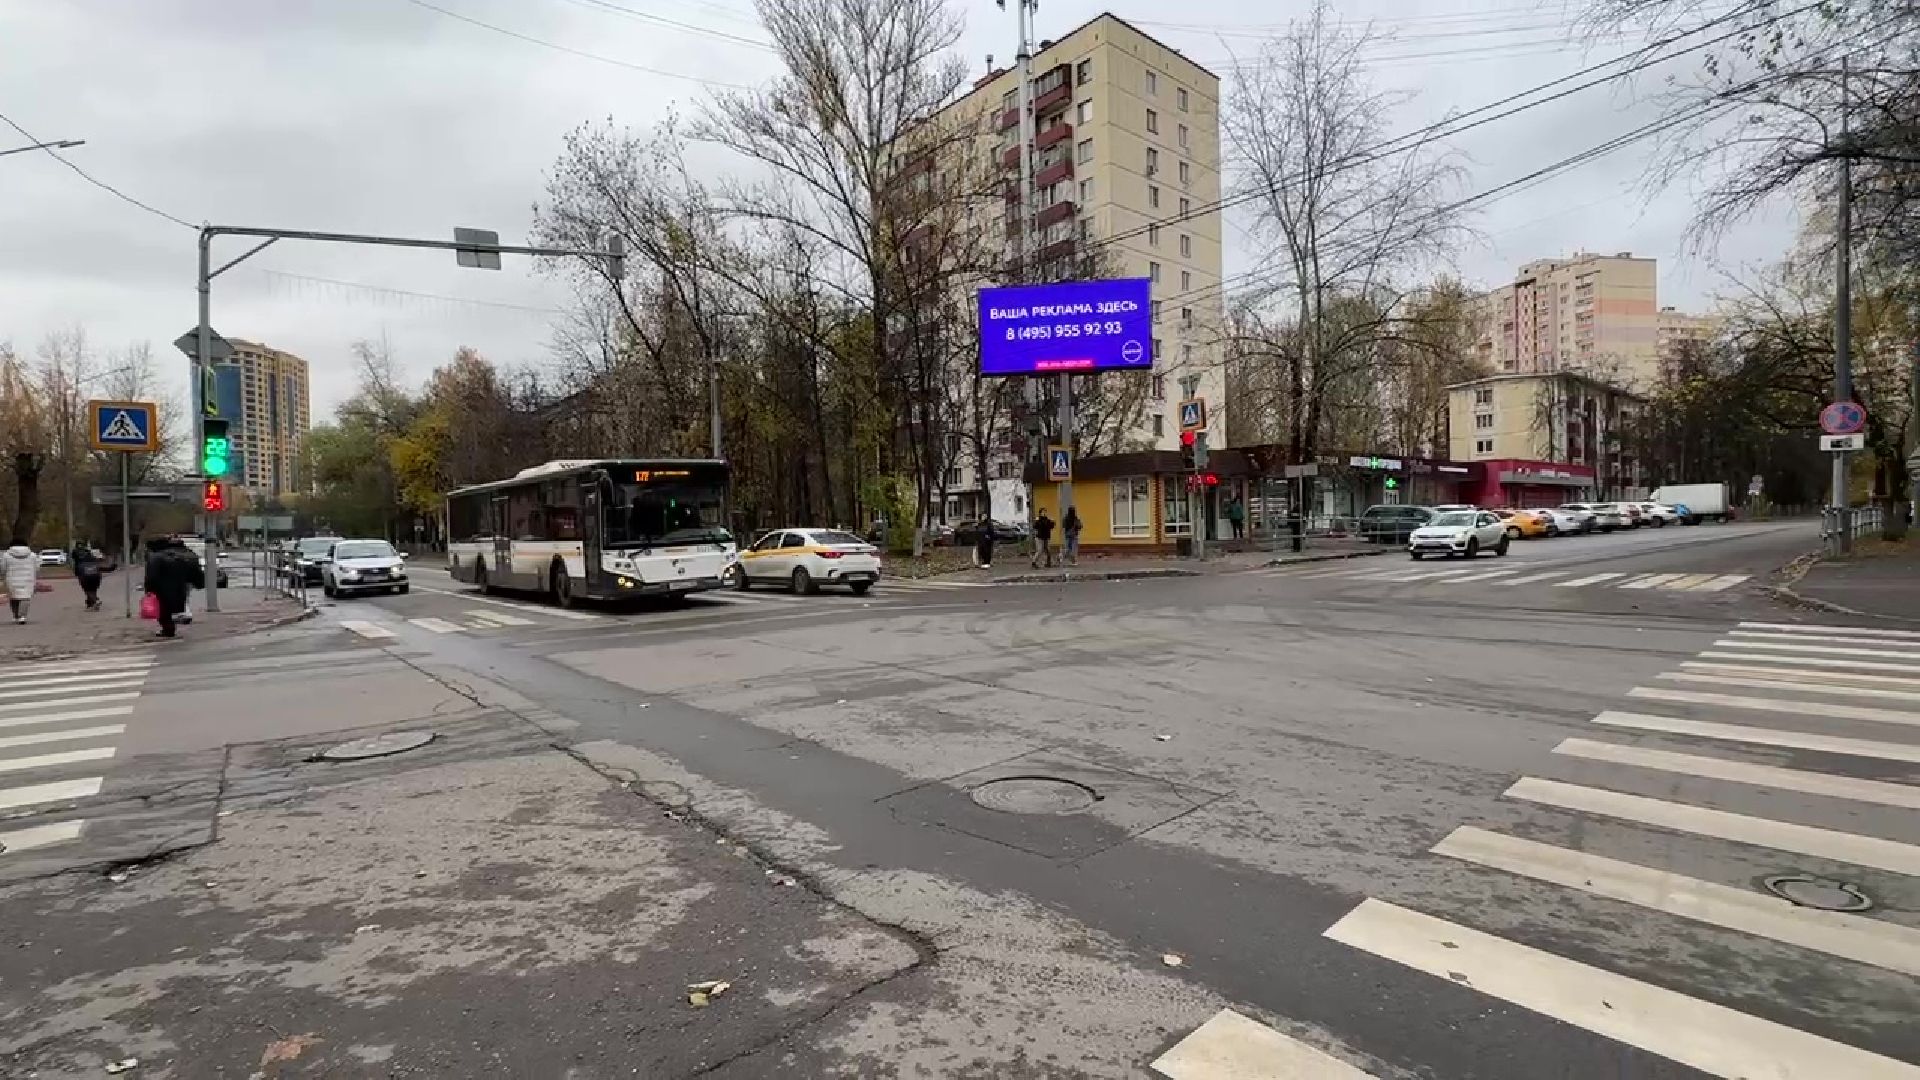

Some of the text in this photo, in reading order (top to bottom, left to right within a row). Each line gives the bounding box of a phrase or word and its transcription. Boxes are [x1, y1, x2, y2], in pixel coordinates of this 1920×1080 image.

[990, 301, 1138, 319] ВАША РЕКЛАМА ЗДЕСЬ
[1006, 321, 1122, 340] 8 (495) 955 92 93
